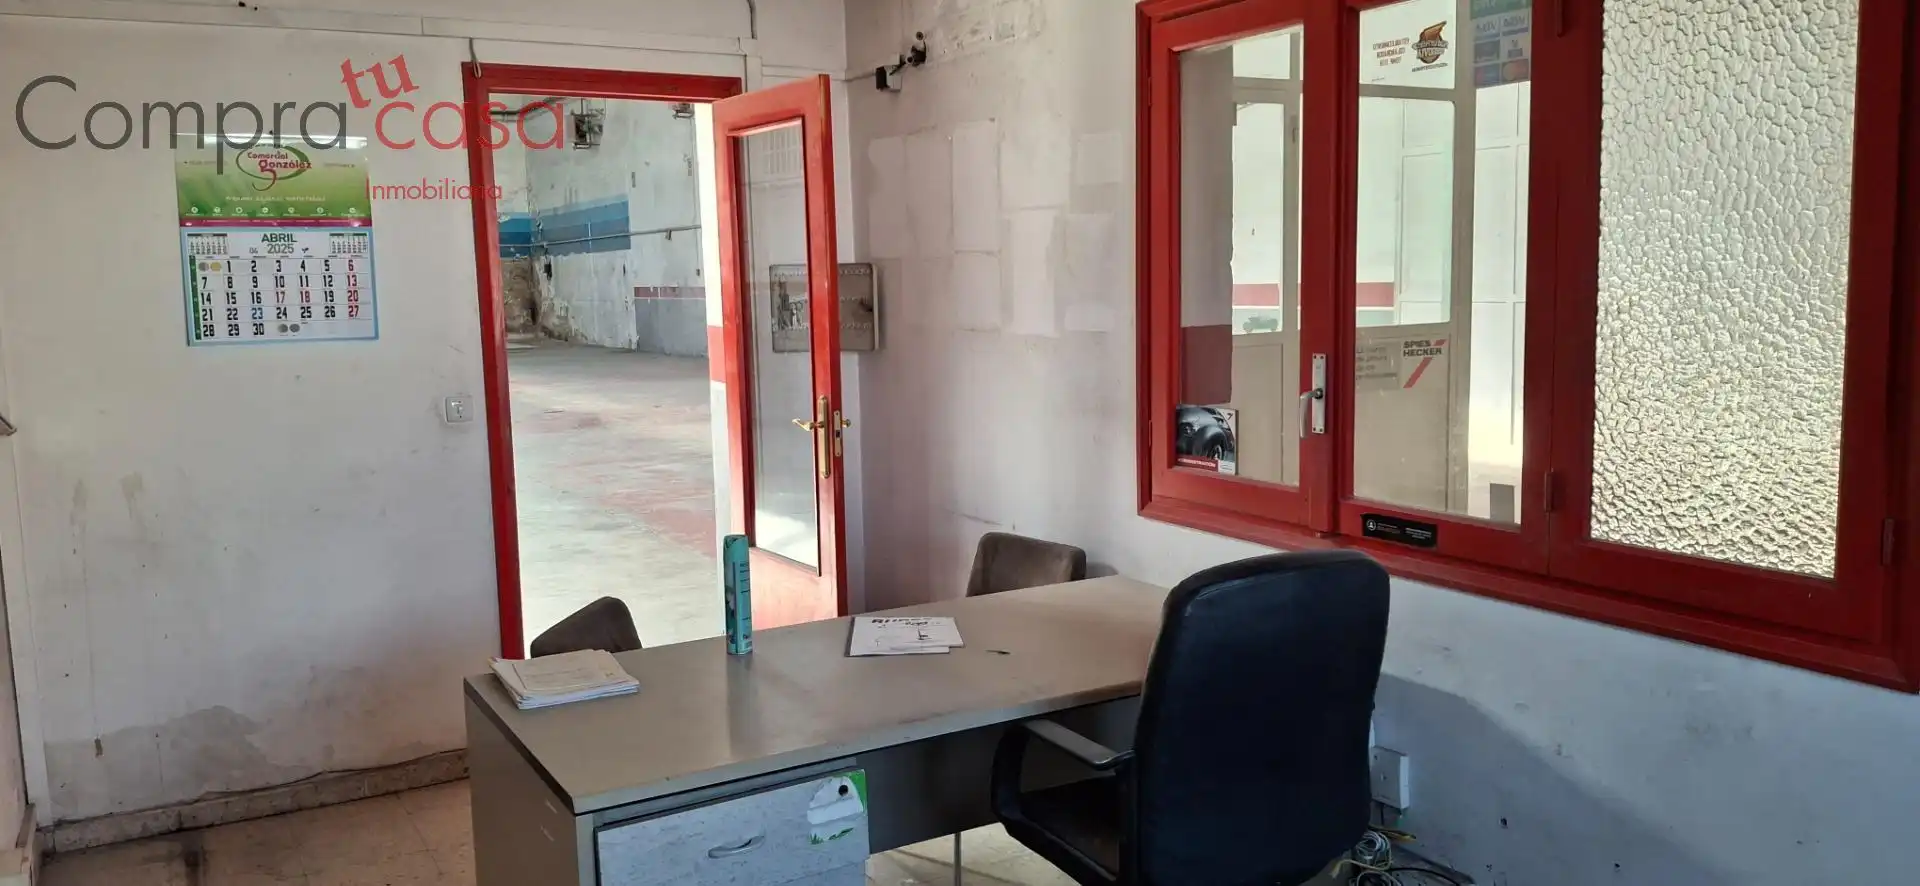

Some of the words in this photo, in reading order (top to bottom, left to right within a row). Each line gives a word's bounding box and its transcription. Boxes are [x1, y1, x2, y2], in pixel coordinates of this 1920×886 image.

[261, 233, 297, 243] ABRIL
[267, 243, 294, 254] 2025
[227, 261, 232, 273] 1
[251, 260, 257, 273] 2
[276, 260, 282, 273] 3
[301, 260, 306, 273] 4
[324, 260, 330, 272] 5
[349, 260, 354, 272] 6
[202, 277, 208, 290] 7
[228, 277, 234, 289] 8
[252, 276, 259, 289] 9
[275, 276, 285, 289] 10
[300, 275, 309, 288] 11
[323, 275, 334, 288] 12
[347, 275, 358, 287] 13
[200, 292, 212, 305] 14
[226, 292, 237, 305] 15
[251, 292, 262, 305] 16
[276, 291, 286, 304] 17
[300, 291, 311, 304] 18
[324, 290, 335, 303] 19
[348, 290, 359, 303] 20
[202, 308, 214, 321] 21
[227, 308, 239, 321] 22
[252, 307, 264, 320] 23
[276, 307, 288, 320] 24
[301, 306, 312, 319] 25
[325, 306, 336, 319] 26
[349, 305, 359, 318] 27
[203, 324, 215, 337] 28
[228, 324, 240, 337] 29
[253, 323, 265, 336] 30
[1403, 340, 1432, 349] SPIES
[1403, 347, 1442, 357] HECKER
